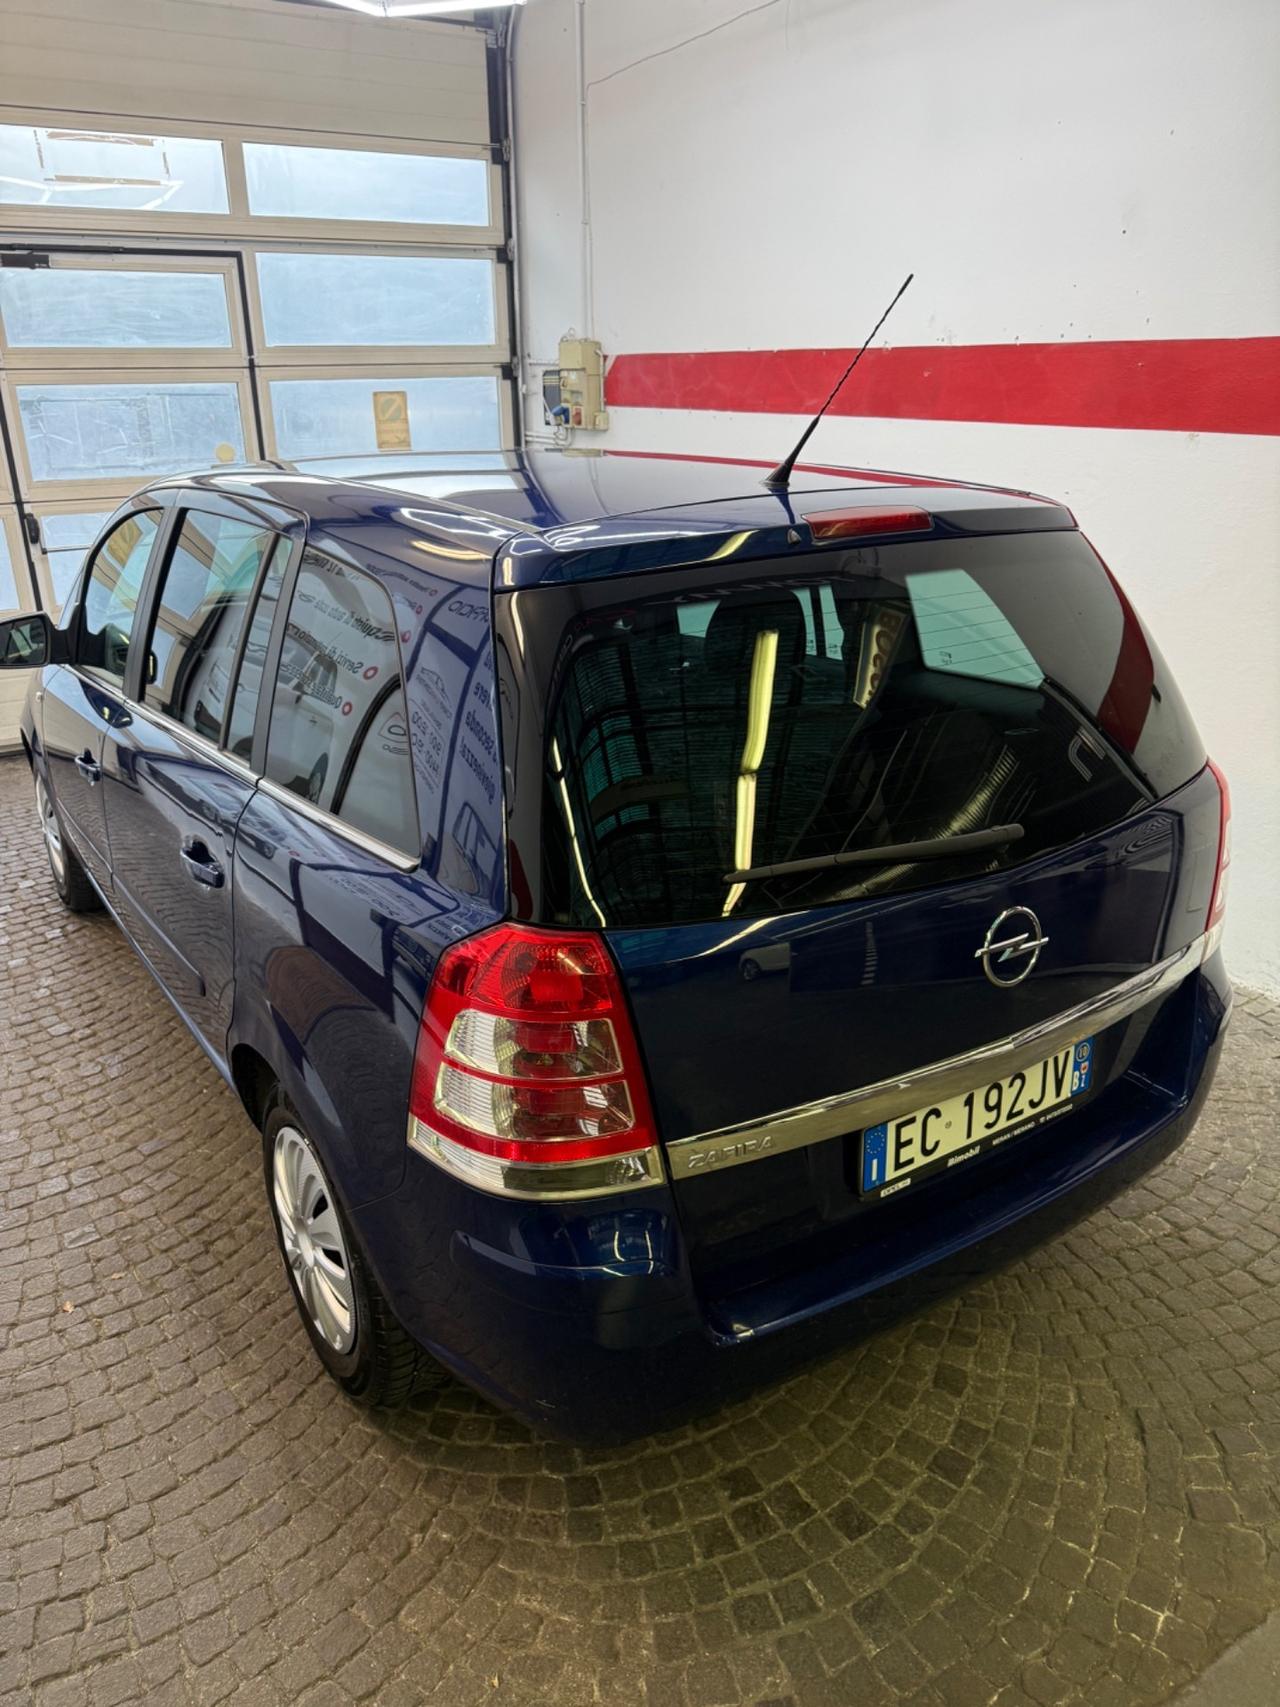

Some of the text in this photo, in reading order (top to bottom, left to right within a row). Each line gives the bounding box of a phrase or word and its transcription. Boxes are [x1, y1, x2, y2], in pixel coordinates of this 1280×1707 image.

[893, 1050, 1070, 1172] EC 192JV
[687, 1135, 775, 1169] ZAFIRA
